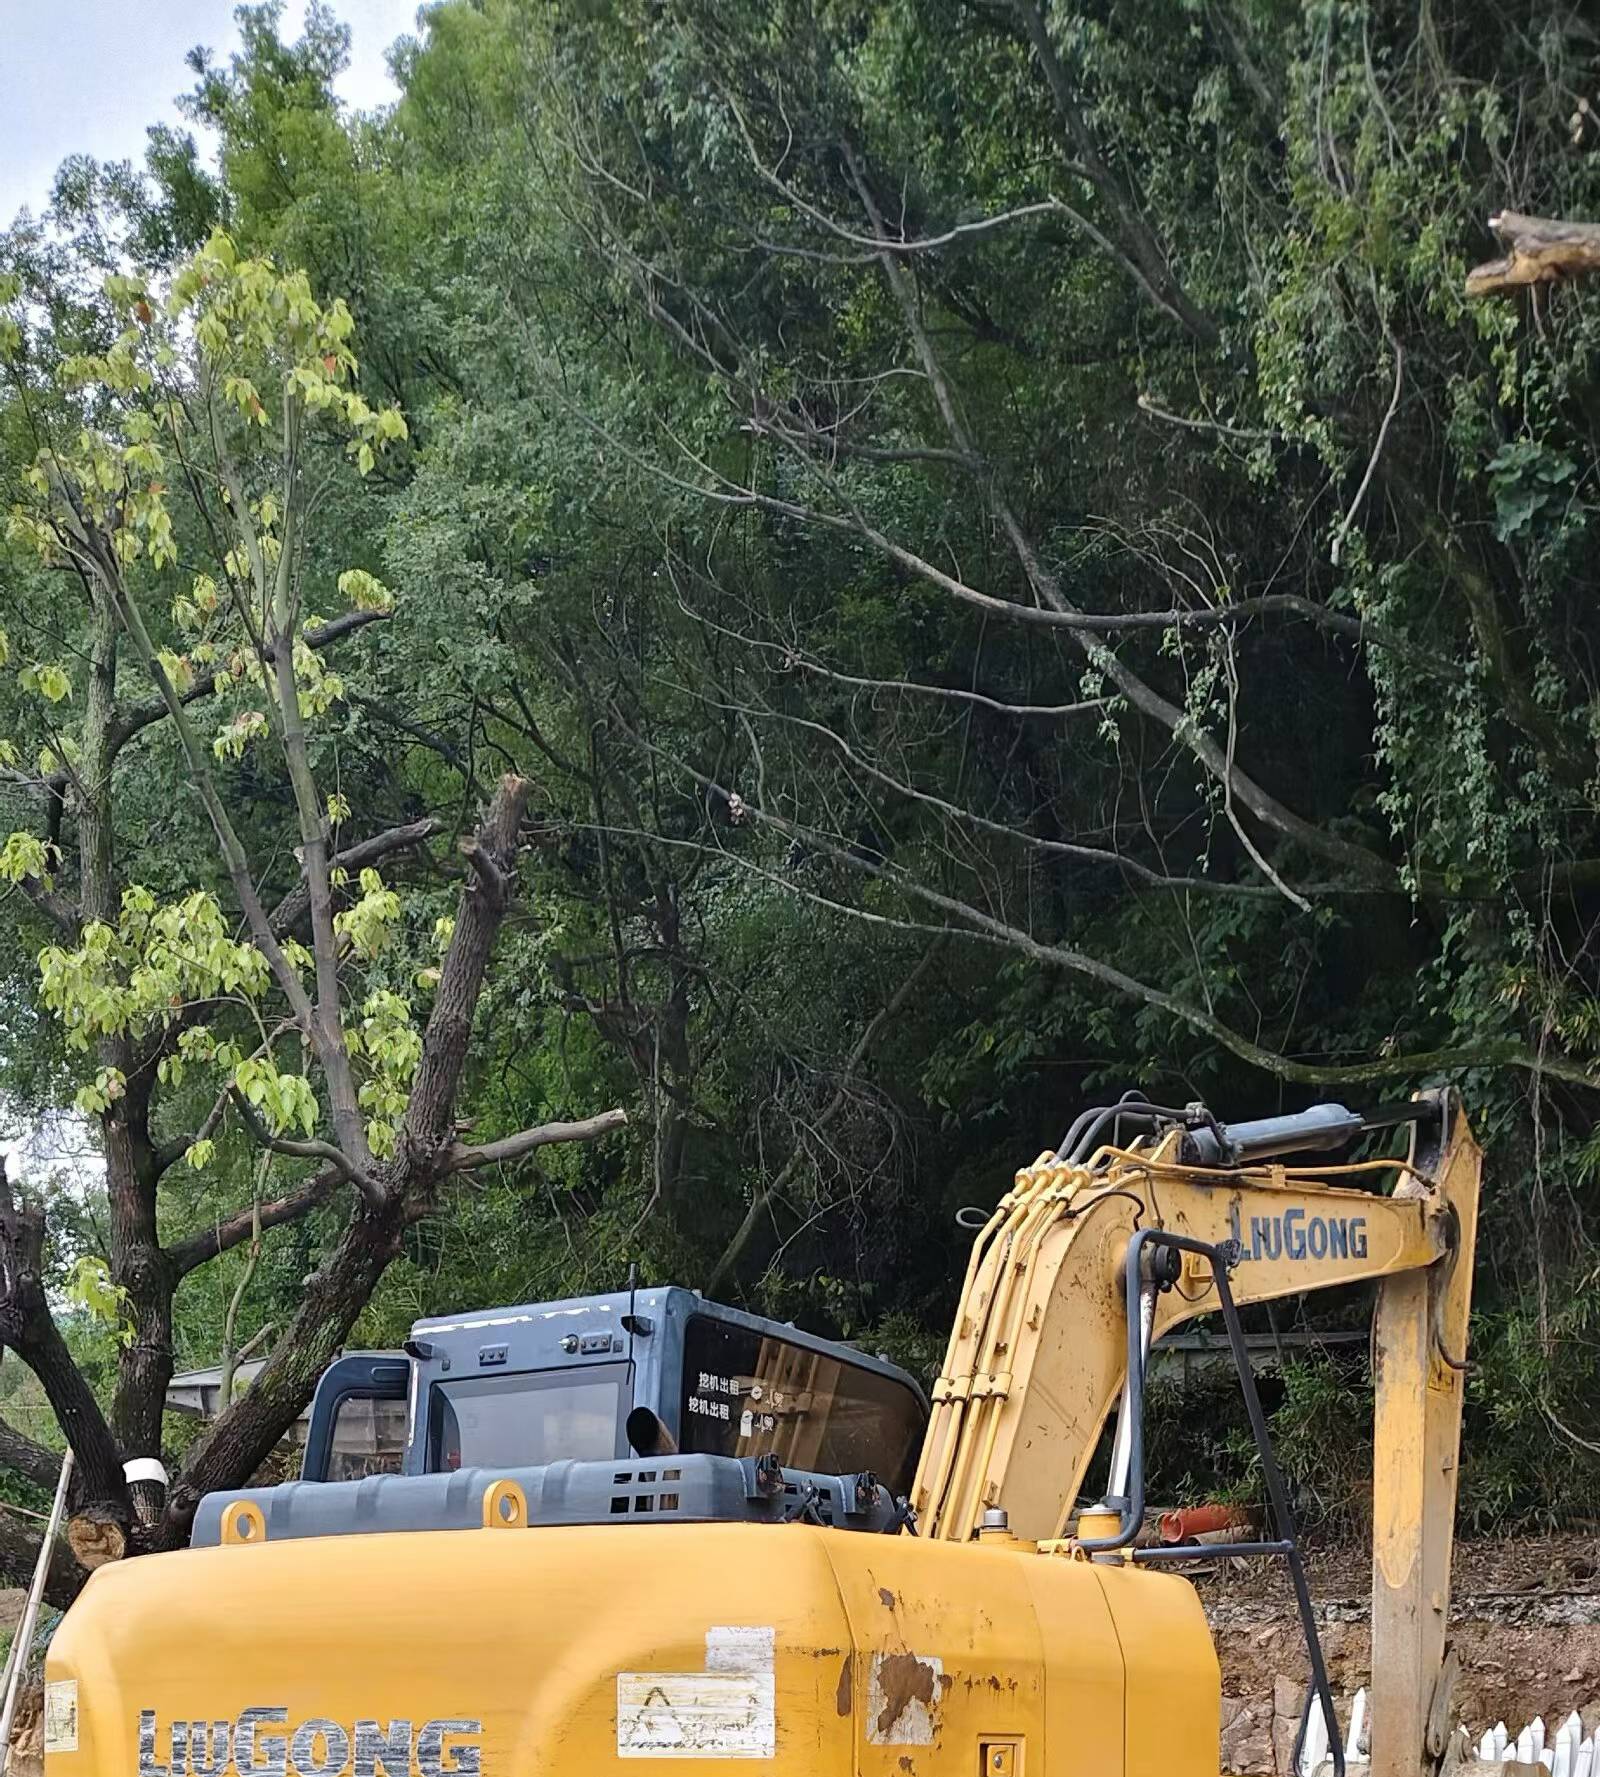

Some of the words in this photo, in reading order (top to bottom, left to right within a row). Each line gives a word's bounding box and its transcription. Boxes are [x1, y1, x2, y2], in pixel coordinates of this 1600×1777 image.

[698, 1371, 740, 1396] 挖机出租
[688, 1396, 730, 1420] 挖机出租
